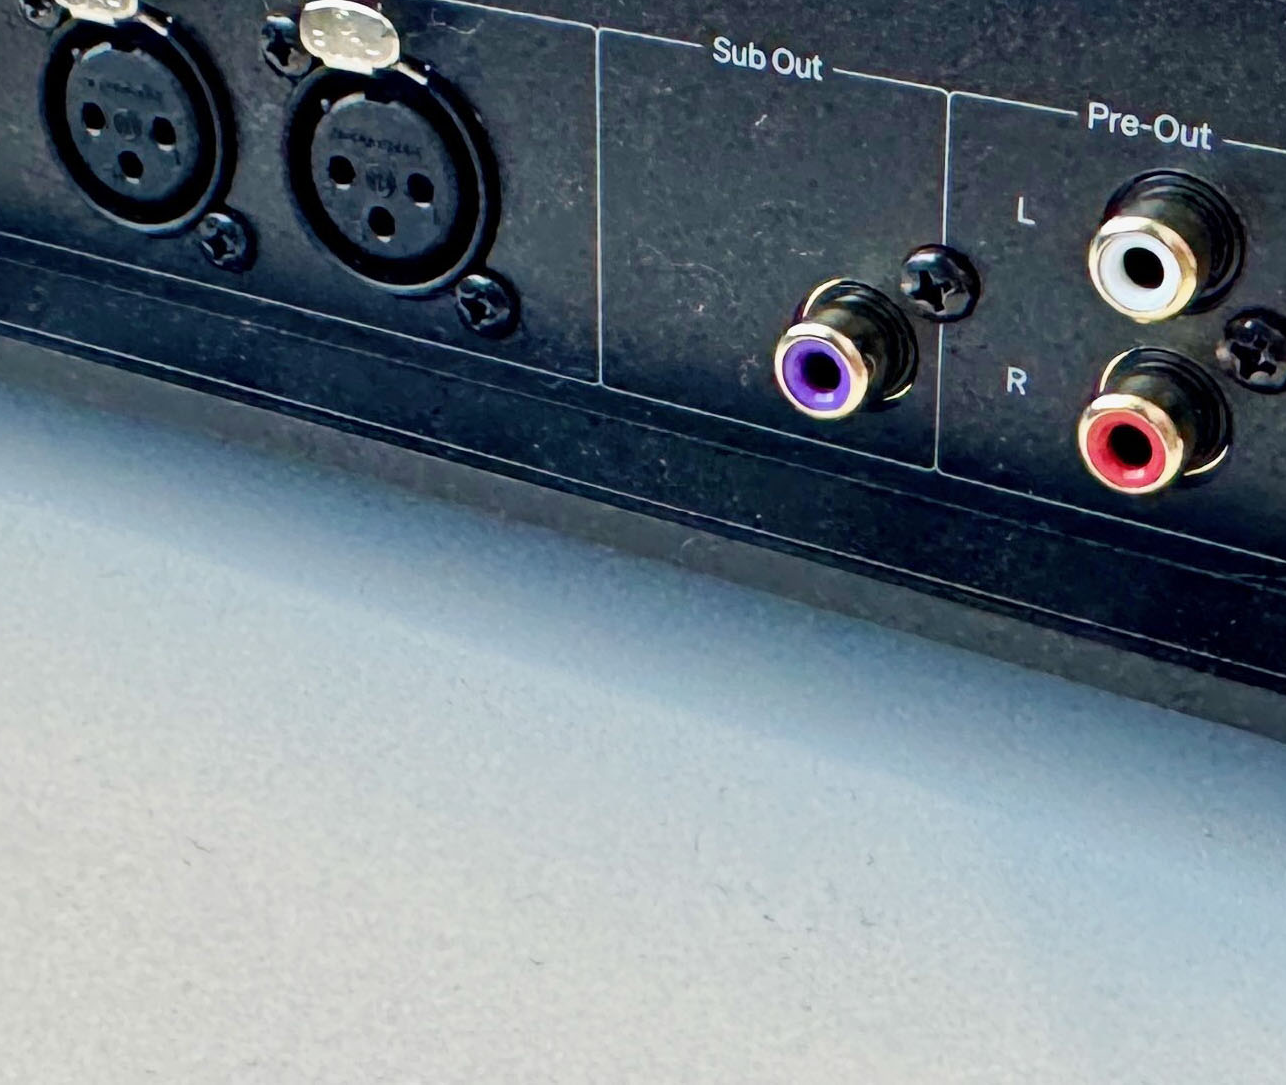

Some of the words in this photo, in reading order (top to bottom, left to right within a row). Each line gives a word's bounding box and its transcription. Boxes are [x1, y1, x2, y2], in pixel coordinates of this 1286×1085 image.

[712, 36, 767, 71] Sub
[771, 46, 824, 82] Out
[1088, 101, 1213, 151] Pre-Out
[1017, 196, 1036, 226] L
[1006, 366, 1028, 396] R
